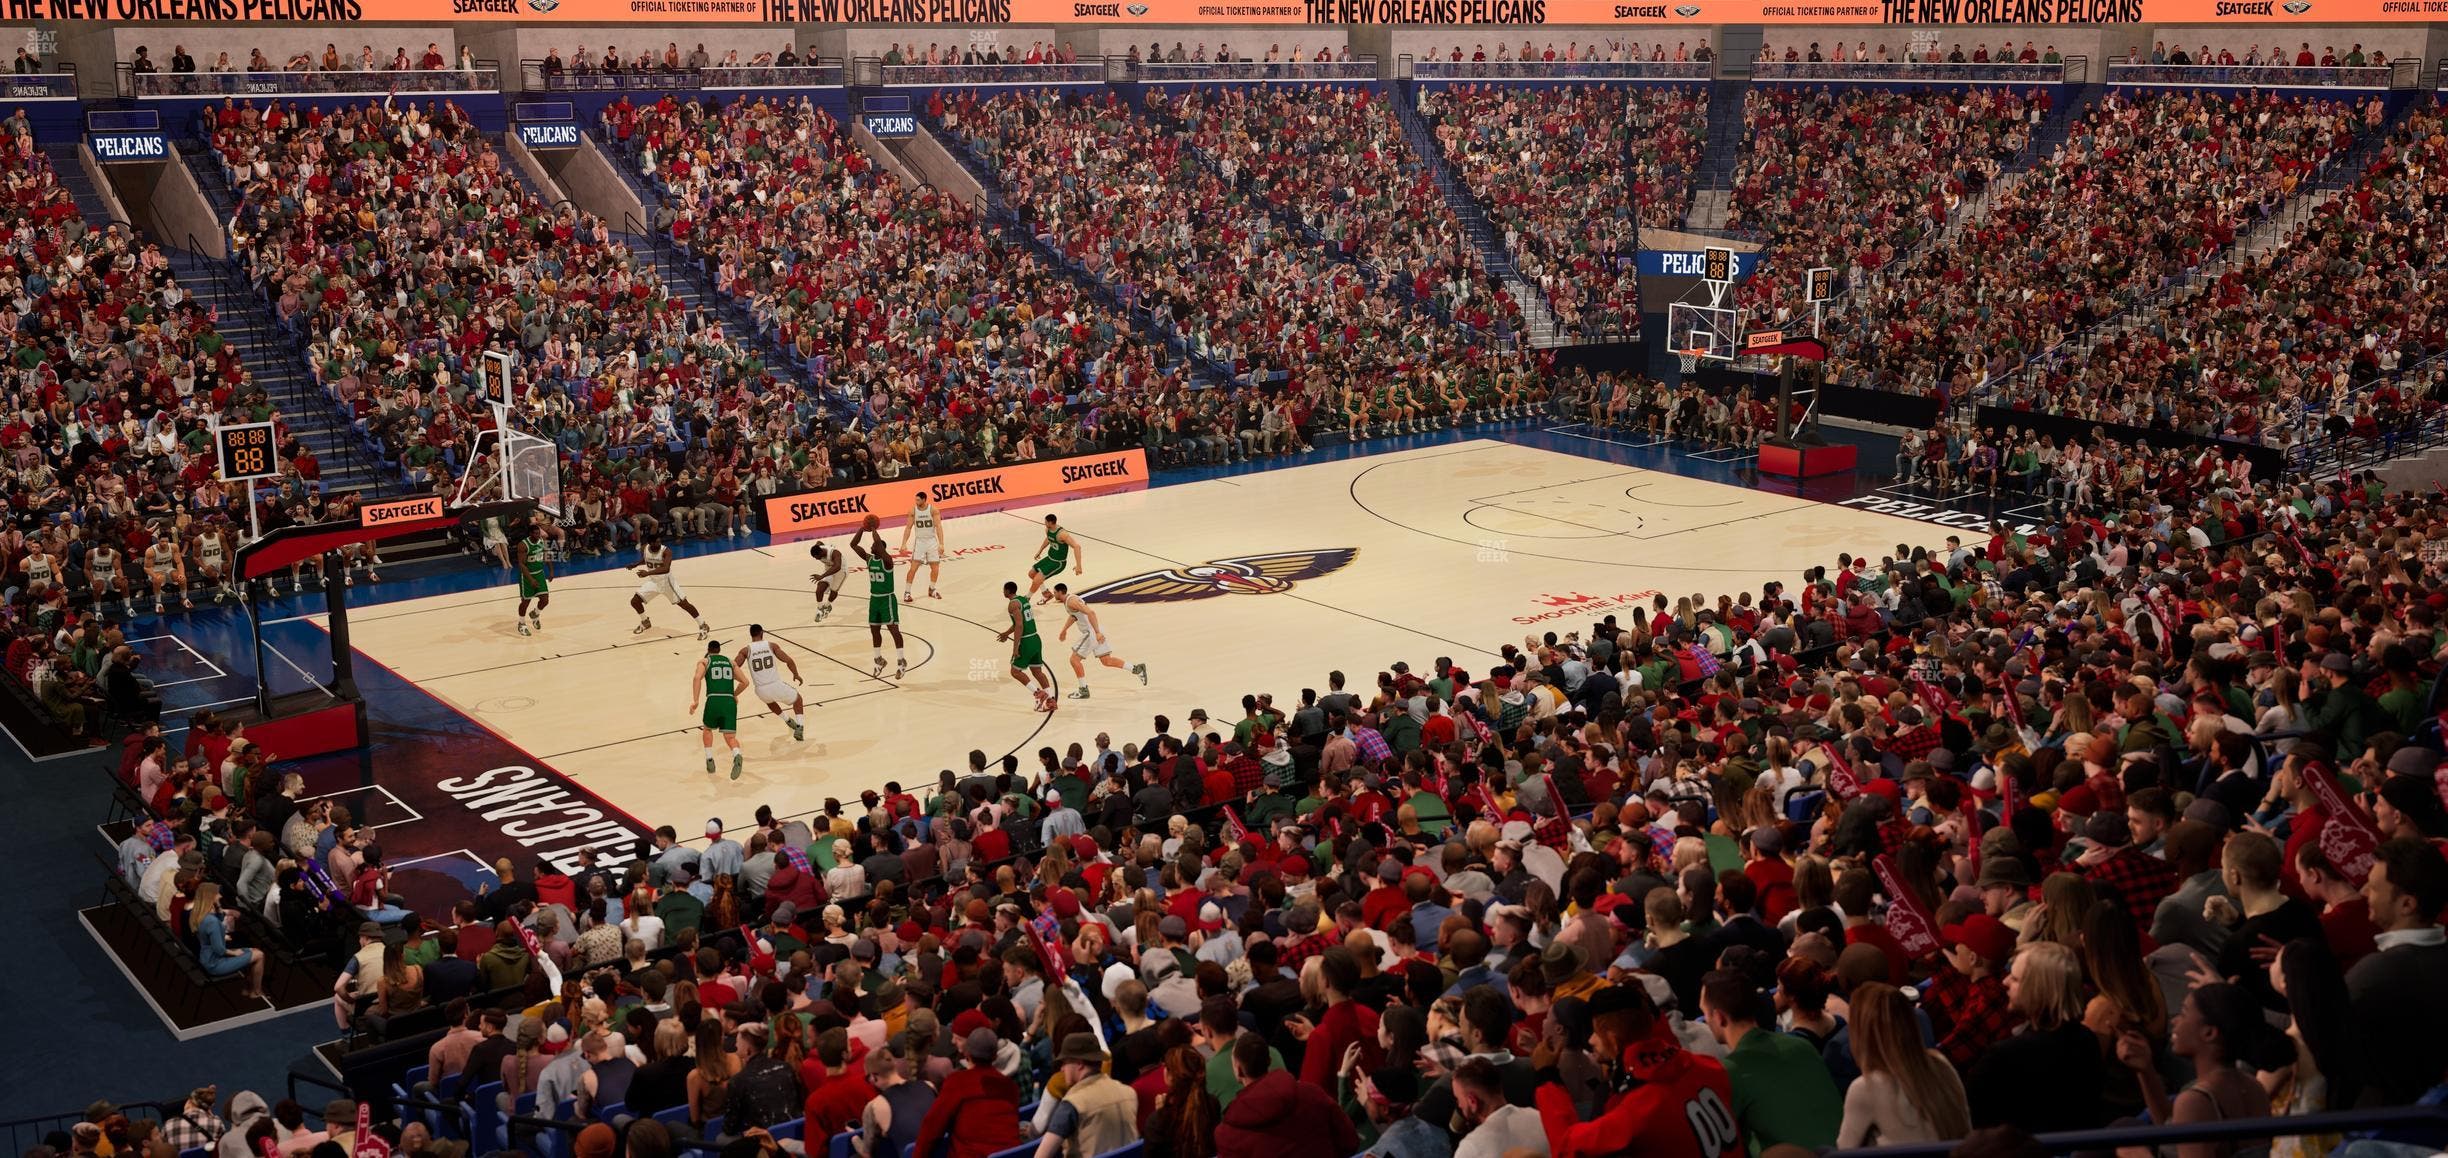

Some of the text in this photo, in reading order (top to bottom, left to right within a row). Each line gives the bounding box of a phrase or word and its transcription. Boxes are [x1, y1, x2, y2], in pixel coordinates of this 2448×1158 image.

[0, 0, 362, 20] HE NEW ORLEANS PELICANS
[453, 0, 519, 15] SEATGEEK
[630, 1, 757, 13] OFFICIAL TICKETING PARTNER OF
[798, 0, 838, 22] NEW
[843, 0, 926, 23] ORLEANS
[929, 0, 1011, 23] PELICANS
[1074, 3, 1120, 17] SEATGEEK
[1198, 6, 1302, 16] OFFICIAL TICKETING PARTNER OF
[1303, 0, 1545, 24] THE NEW ORLEANS PELICANS
[1614, 5, 1667, 18] SEATGEEK
[1762, 6, 1879, 16] OFFICIAL TICKETING PARTNER OF
[1882, 0, 2143, 23] THE NEW ORLEANS PELICANS
[2215, 1, 2274, 15] SEATGEEK
[2383, 1, 2421, 13] OFFICIAL
[523, 126, 577, 144] PELICANS
[95, 136, 164, 156] PELICANS
[1662, 253, 1740, 275] PELICS
[1710, 262, 1725, 279] 88
[1815, 282, 1827, 298] 88
[1752, 333, 1779, 346] SEATGEEK
[228, 429, 266, 447] 88 88
[234, 447, 264, 474] 88
[1061, 457, 1129, 484] SEATGEEK
[931, 474, 1005, 502] SEATGEEK
[369, 501, 436, 522] SEATGEEK
[790, 493, 870, 523] SEATGEEK
[1512, 600, 1614, 625] SMOOTHIE
[711, 666, 733, 680] 00
[752, 656, 774, 672] 00
[1686, 1087, 1737, 1158] 00
